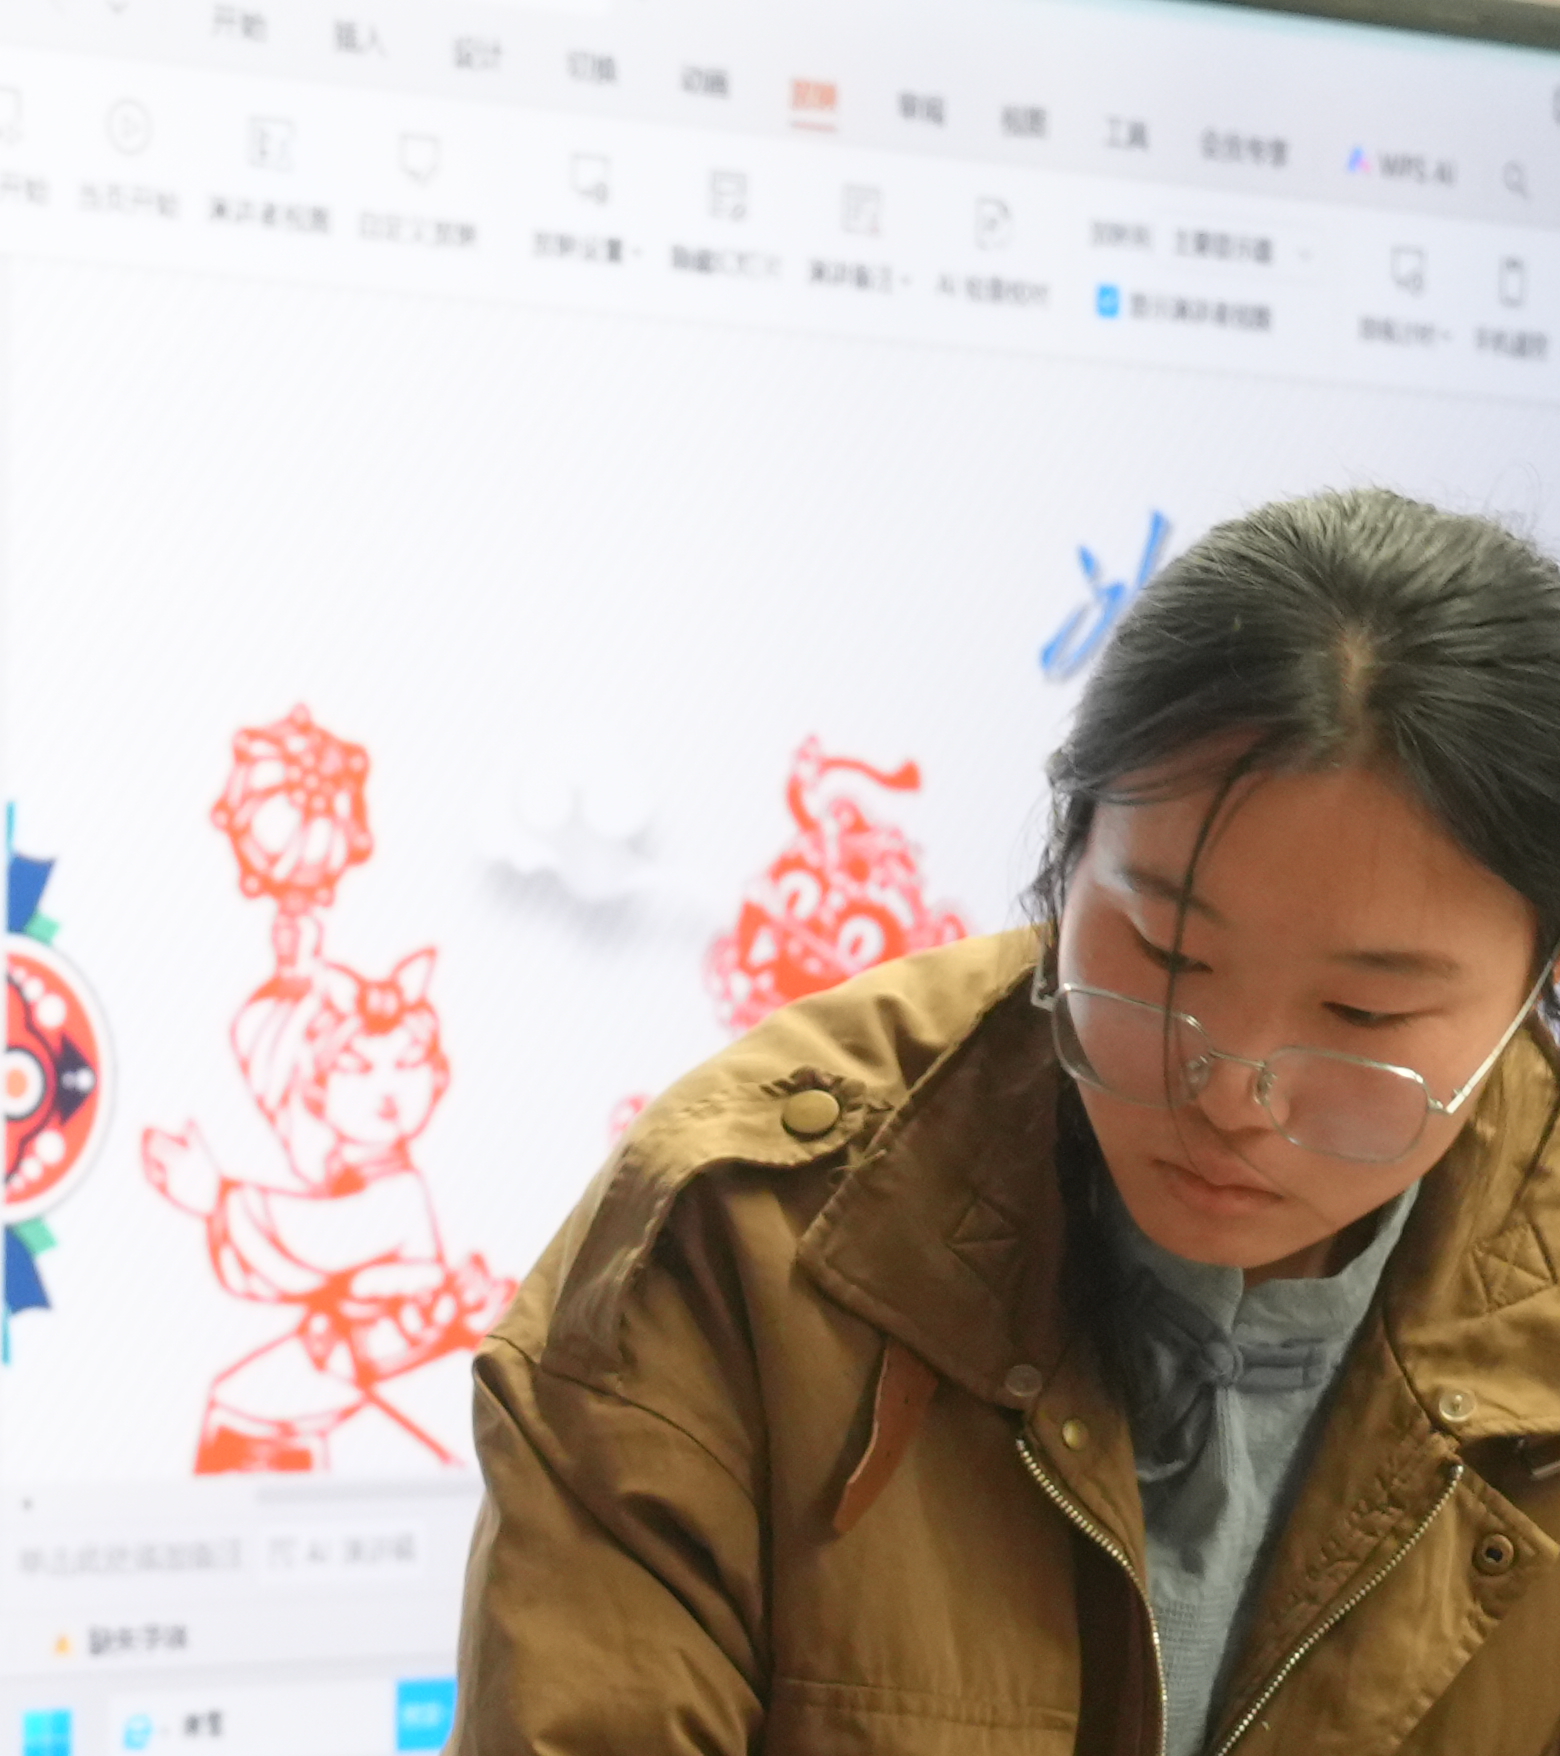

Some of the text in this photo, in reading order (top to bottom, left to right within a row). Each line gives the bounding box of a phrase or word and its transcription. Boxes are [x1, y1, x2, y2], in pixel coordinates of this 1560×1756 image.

[212, 4, 268, 43] 开始
[334, 18, 387, 57] 插入
[452, 36, 502, 71] 设计
[1105, 116, 1149, 151] 工具
[1379, 150, 1457, 187] WPS AI
